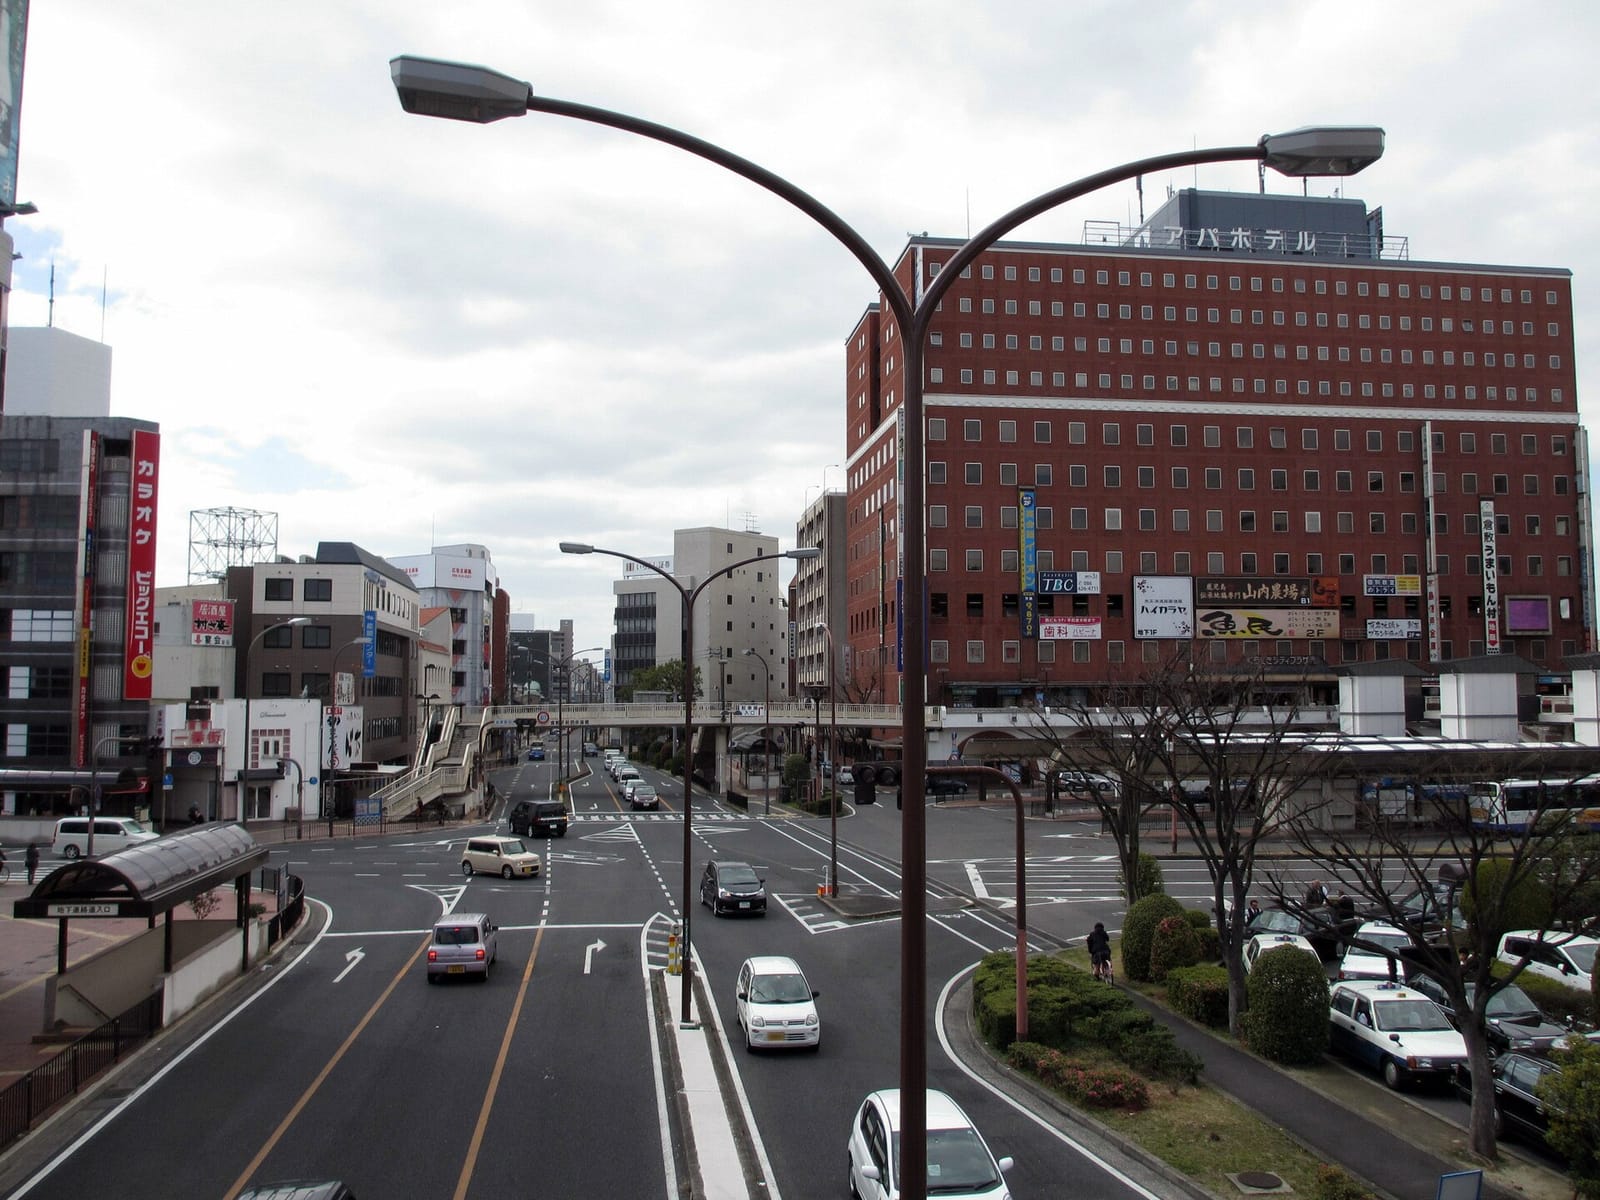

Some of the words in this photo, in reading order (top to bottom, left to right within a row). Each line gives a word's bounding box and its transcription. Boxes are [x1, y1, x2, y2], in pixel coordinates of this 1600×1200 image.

[1163, 225, 1317, 252] アパホテル
[135, 459, 154, 545] カラオケ
[1483, 519, 1498, 619] 倉敷うまいもん村
[1042, 578, 1073, 591] TBC
[1242, 583, 1299, 600] 山内農場
[134, 570, 152, 654] ビッグエコー
[199, 604, 226, 616] 居酒屋
[1140, 605, 1187, 614] ハイカラヤ
[1044, 626, 1068, 637] 歯科
[1199, 610, 1283, 636] 魚民
[1306, 629, 1325, 637] 2F
